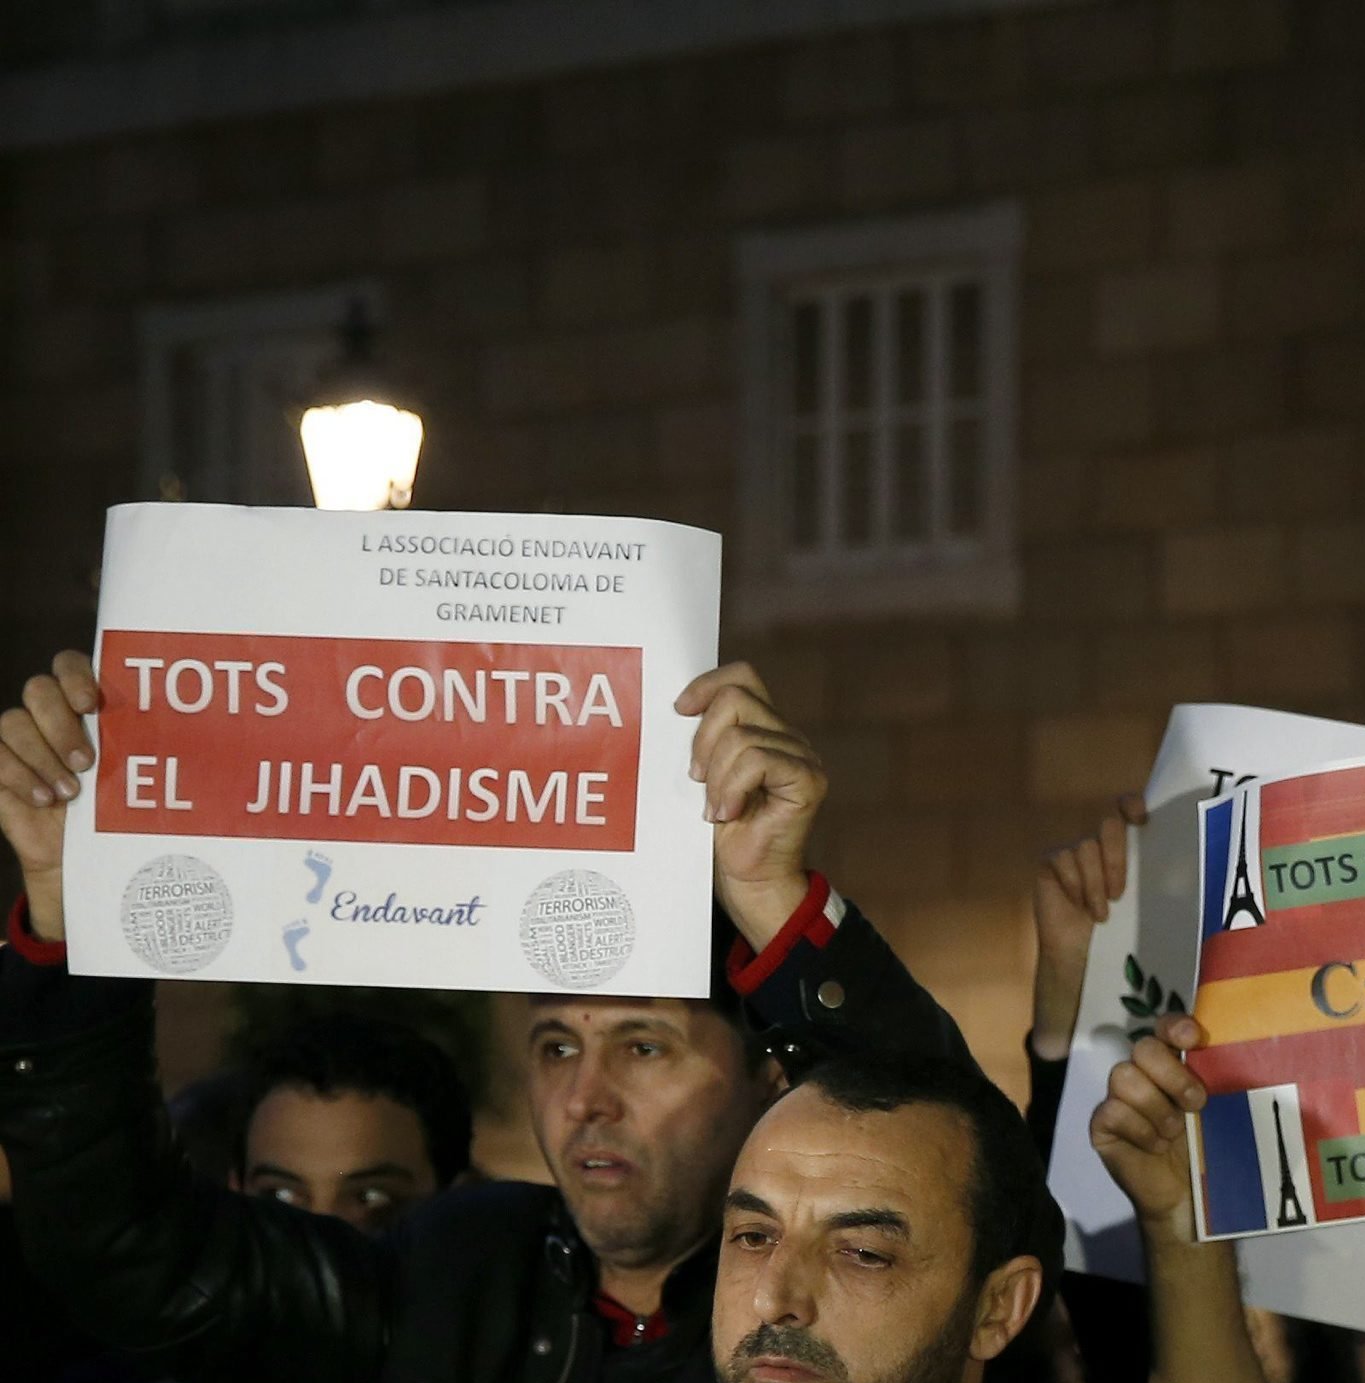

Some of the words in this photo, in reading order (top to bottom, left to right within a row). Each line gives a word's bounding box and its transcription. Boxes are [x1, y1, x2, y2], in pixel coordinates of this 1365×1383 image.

[361, 535, 372, 553] L
[377, 533, 514, 558] ASSOCIACIÓ
[521, 539, 647, 562] ENDAVANT
[379, 567, 407, 587] DE
[414, 568, 590, 593] SANTACOLOMA
[595, 574, 624, 593] DE
[436, 602, 566, 625] GRAMENET
[124, 657, 289, 716] TOTS
[346, 665, 623, 728] CONTRA
[126, 755, 193, 810] EL
[246, 760, 609, 825] JIHADISME
[1268, 853, 1358, 893] TOTS
[330, 891, 486, 927] Endavant
[539, 897, 616, 915] TERRORISM
